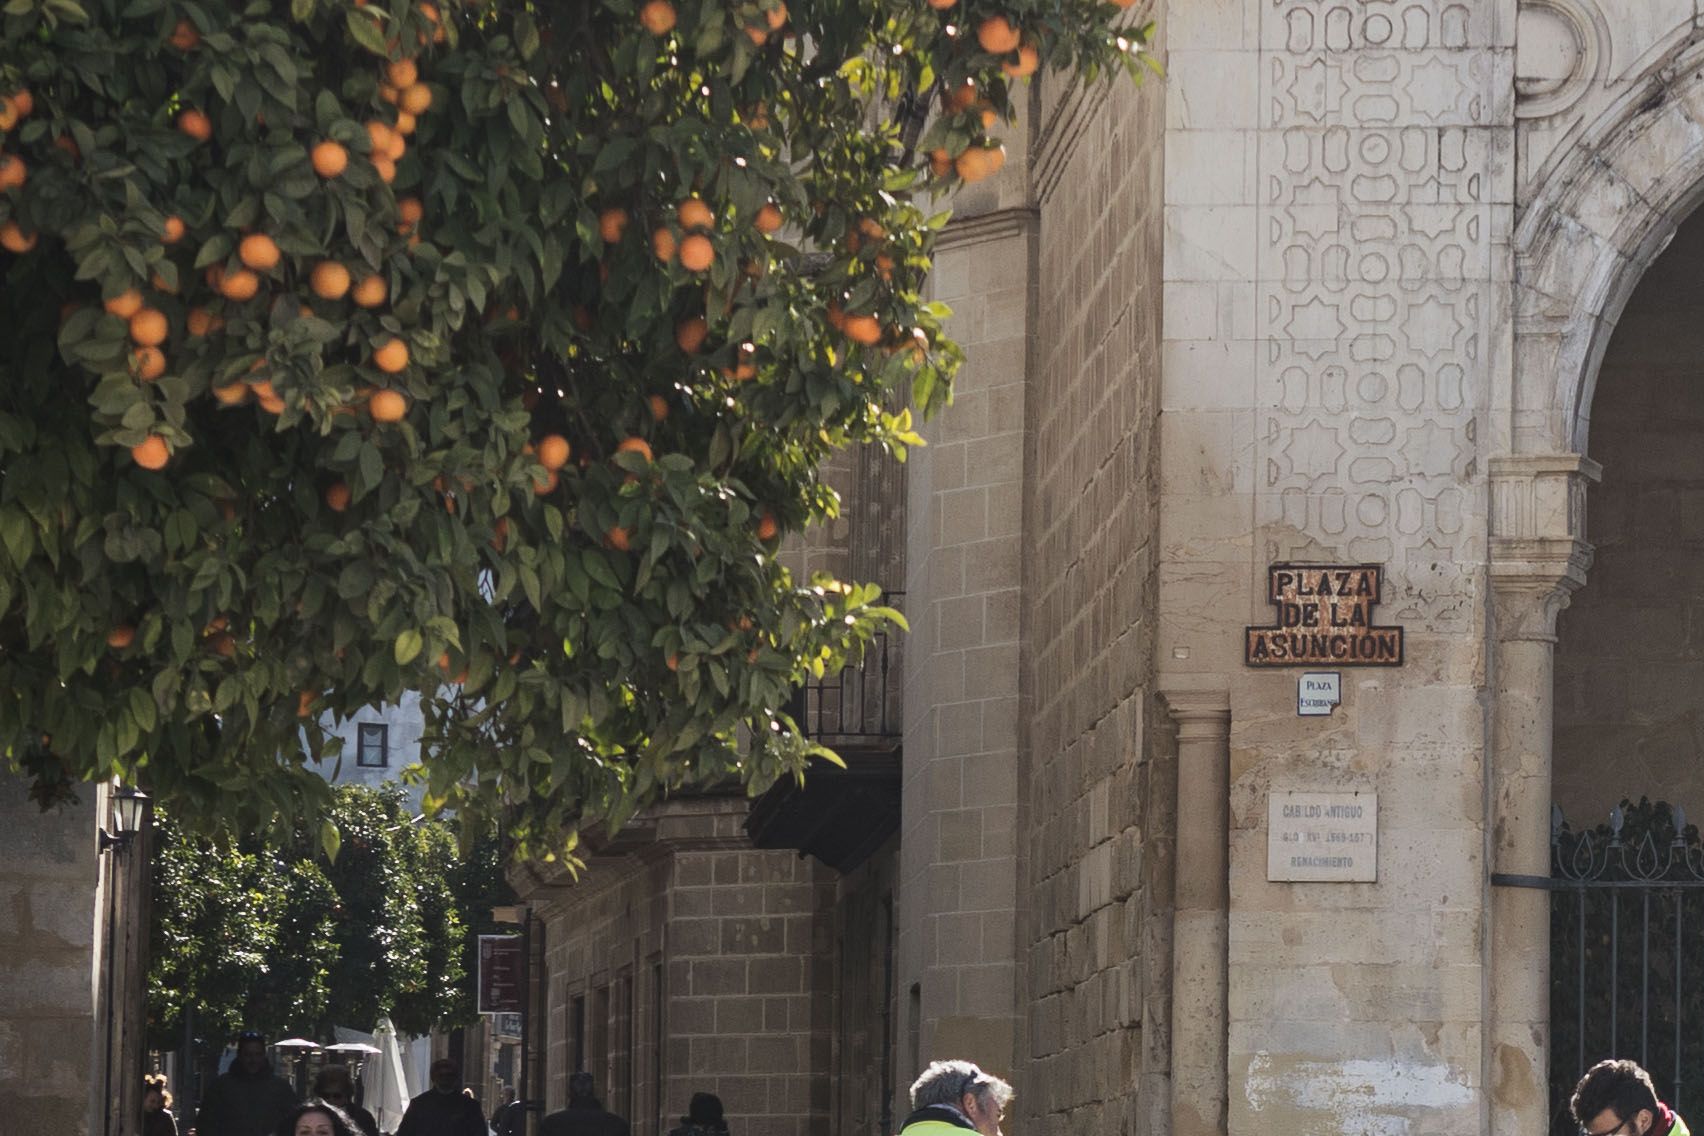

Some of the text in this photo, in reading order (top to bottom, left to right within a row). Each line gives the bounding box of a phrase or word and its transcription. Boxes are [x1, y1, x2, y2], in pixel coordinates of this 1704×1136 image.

[1276, 572, 1373, 596] PLAZA
[1284, 603, 1366, 628] DE LA
[1253, 634, 1396, 659] ASUNCION
[1306, 681, 1332, 691] PLAZA
[1325, 806, 1363, 818] ANTIGUO
[1291, 856, 1353, 868] RENACIMIENTO
